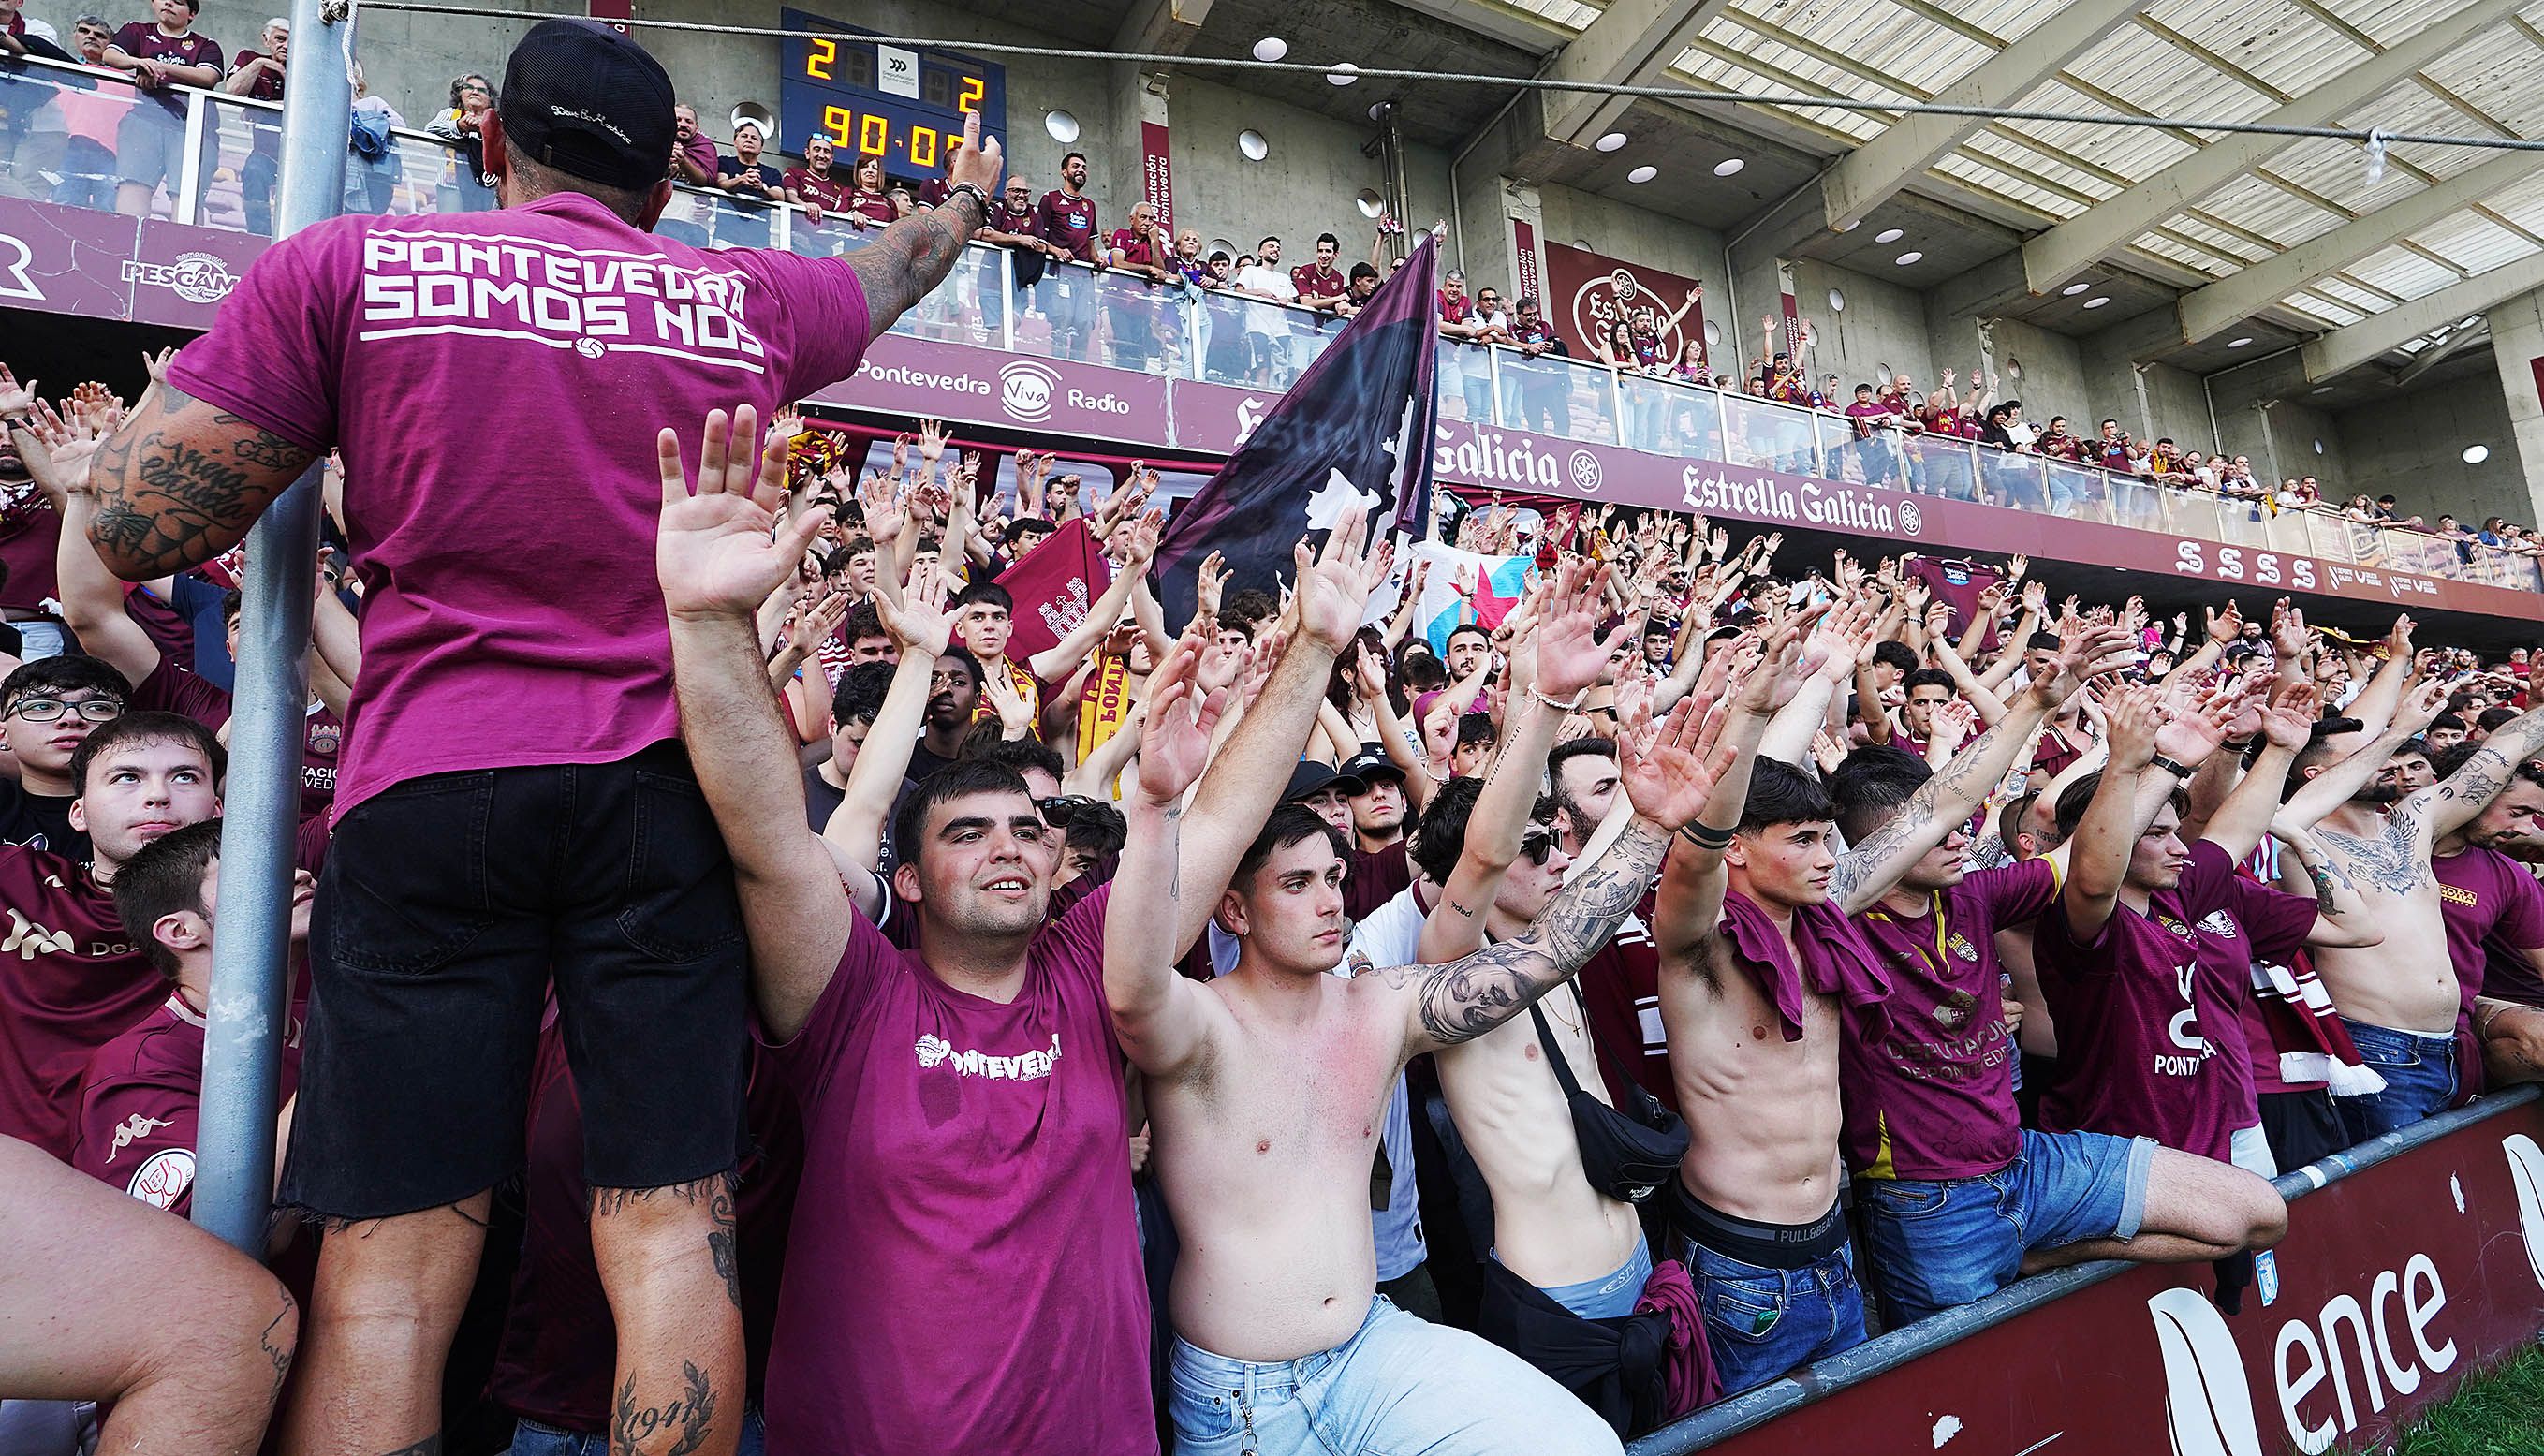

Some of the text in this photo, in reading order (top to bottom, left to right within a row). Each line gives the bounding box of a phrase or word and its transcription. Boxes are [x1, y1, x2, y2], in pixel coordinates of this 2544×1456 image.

[807, 37, 984, 114] 2 2
[1158, 156, 1170, 225] Pontevedra
[363, 237, 748, 322] PONTEVEDRA
[363, 273, 765, 358] SOMOS NOS
[1007, 380, 1049, 404] Viva
[1067, 388, 1131, 416] Radio
[1432, 423, 1562, 489] Galicia
[1681, 463, 1896, 533] Estrella Galicia
[1780, 1213, 1834, 1243] PULL&BEAR
[2273, 1252, 2458, 1456] ence
[626, 1399, 697, 1443] 1941
